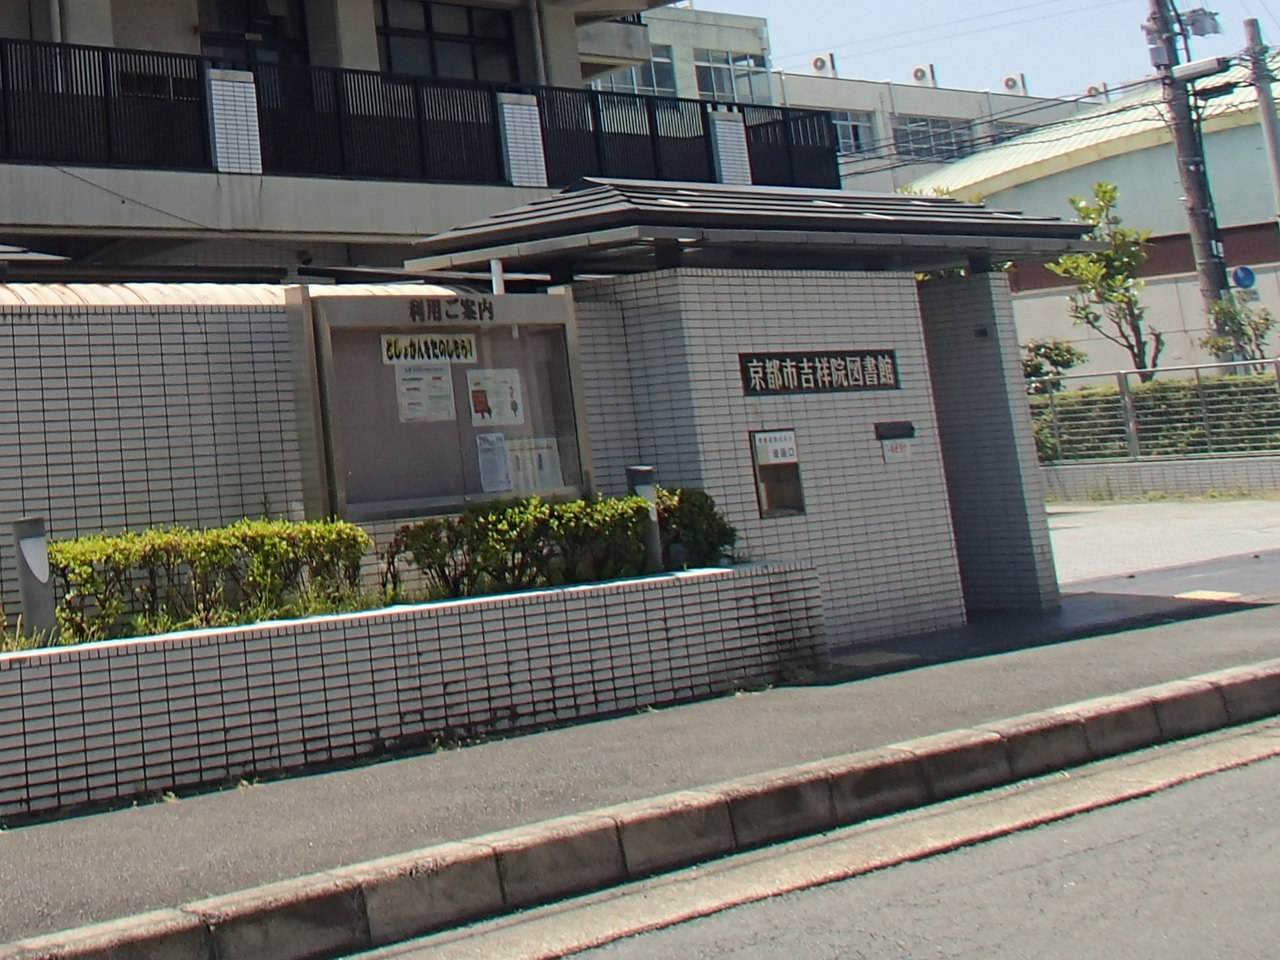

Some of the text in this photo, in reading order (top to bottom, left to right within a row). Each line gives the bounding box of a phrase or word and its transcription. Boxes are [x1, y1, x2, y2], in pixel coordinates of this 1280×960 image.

[408, 297, 495, 322] 利用ご案内
[747, 354, 895, 391] 京都市吉祥院図書館
